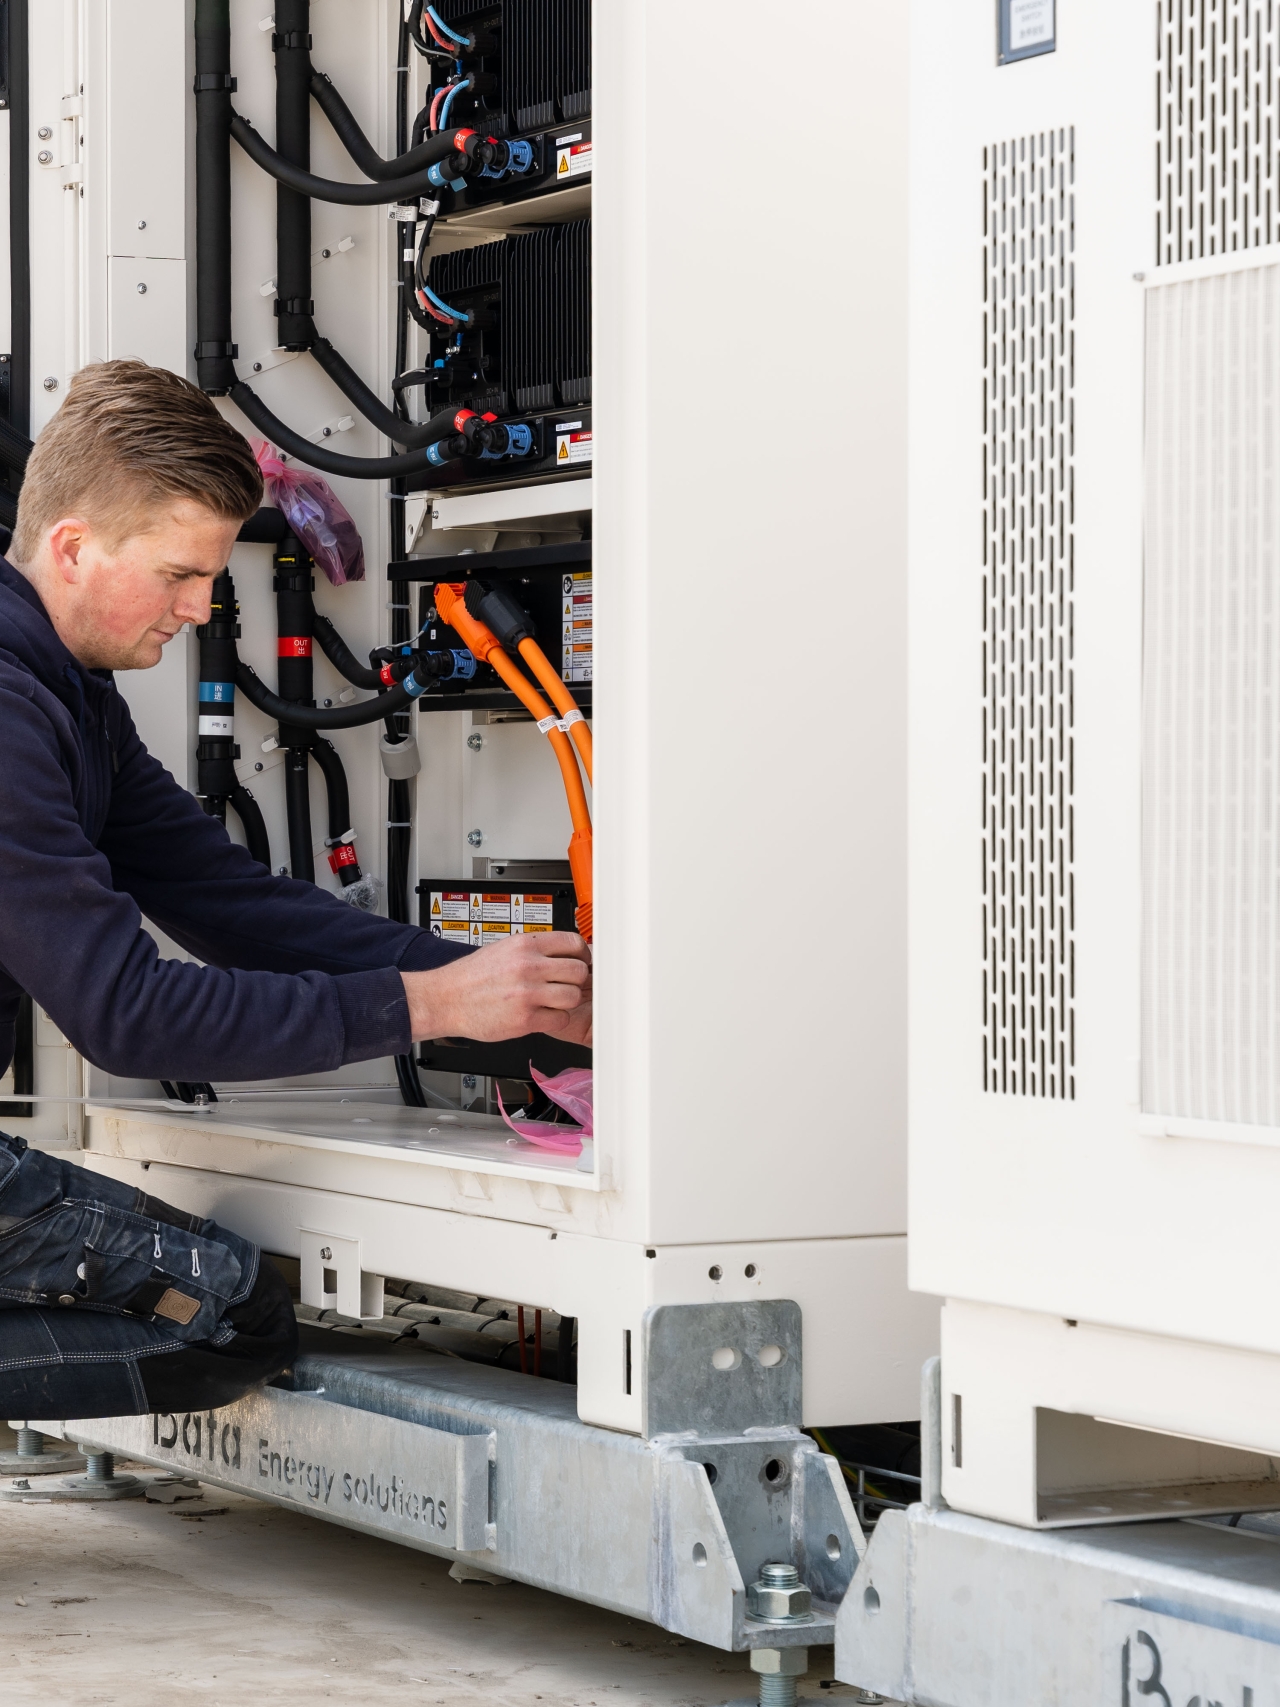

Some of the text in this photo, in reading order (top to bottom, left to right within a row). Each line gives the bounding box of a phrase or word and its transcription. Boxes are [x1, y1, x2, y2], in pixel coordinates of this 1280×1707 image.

[455, 133, 466, 141] OUT
[347, 847, 355, 861] OUT
[258, 1438, 335, 1505] Energy
[343, 1472, 448, 1531] solutions
